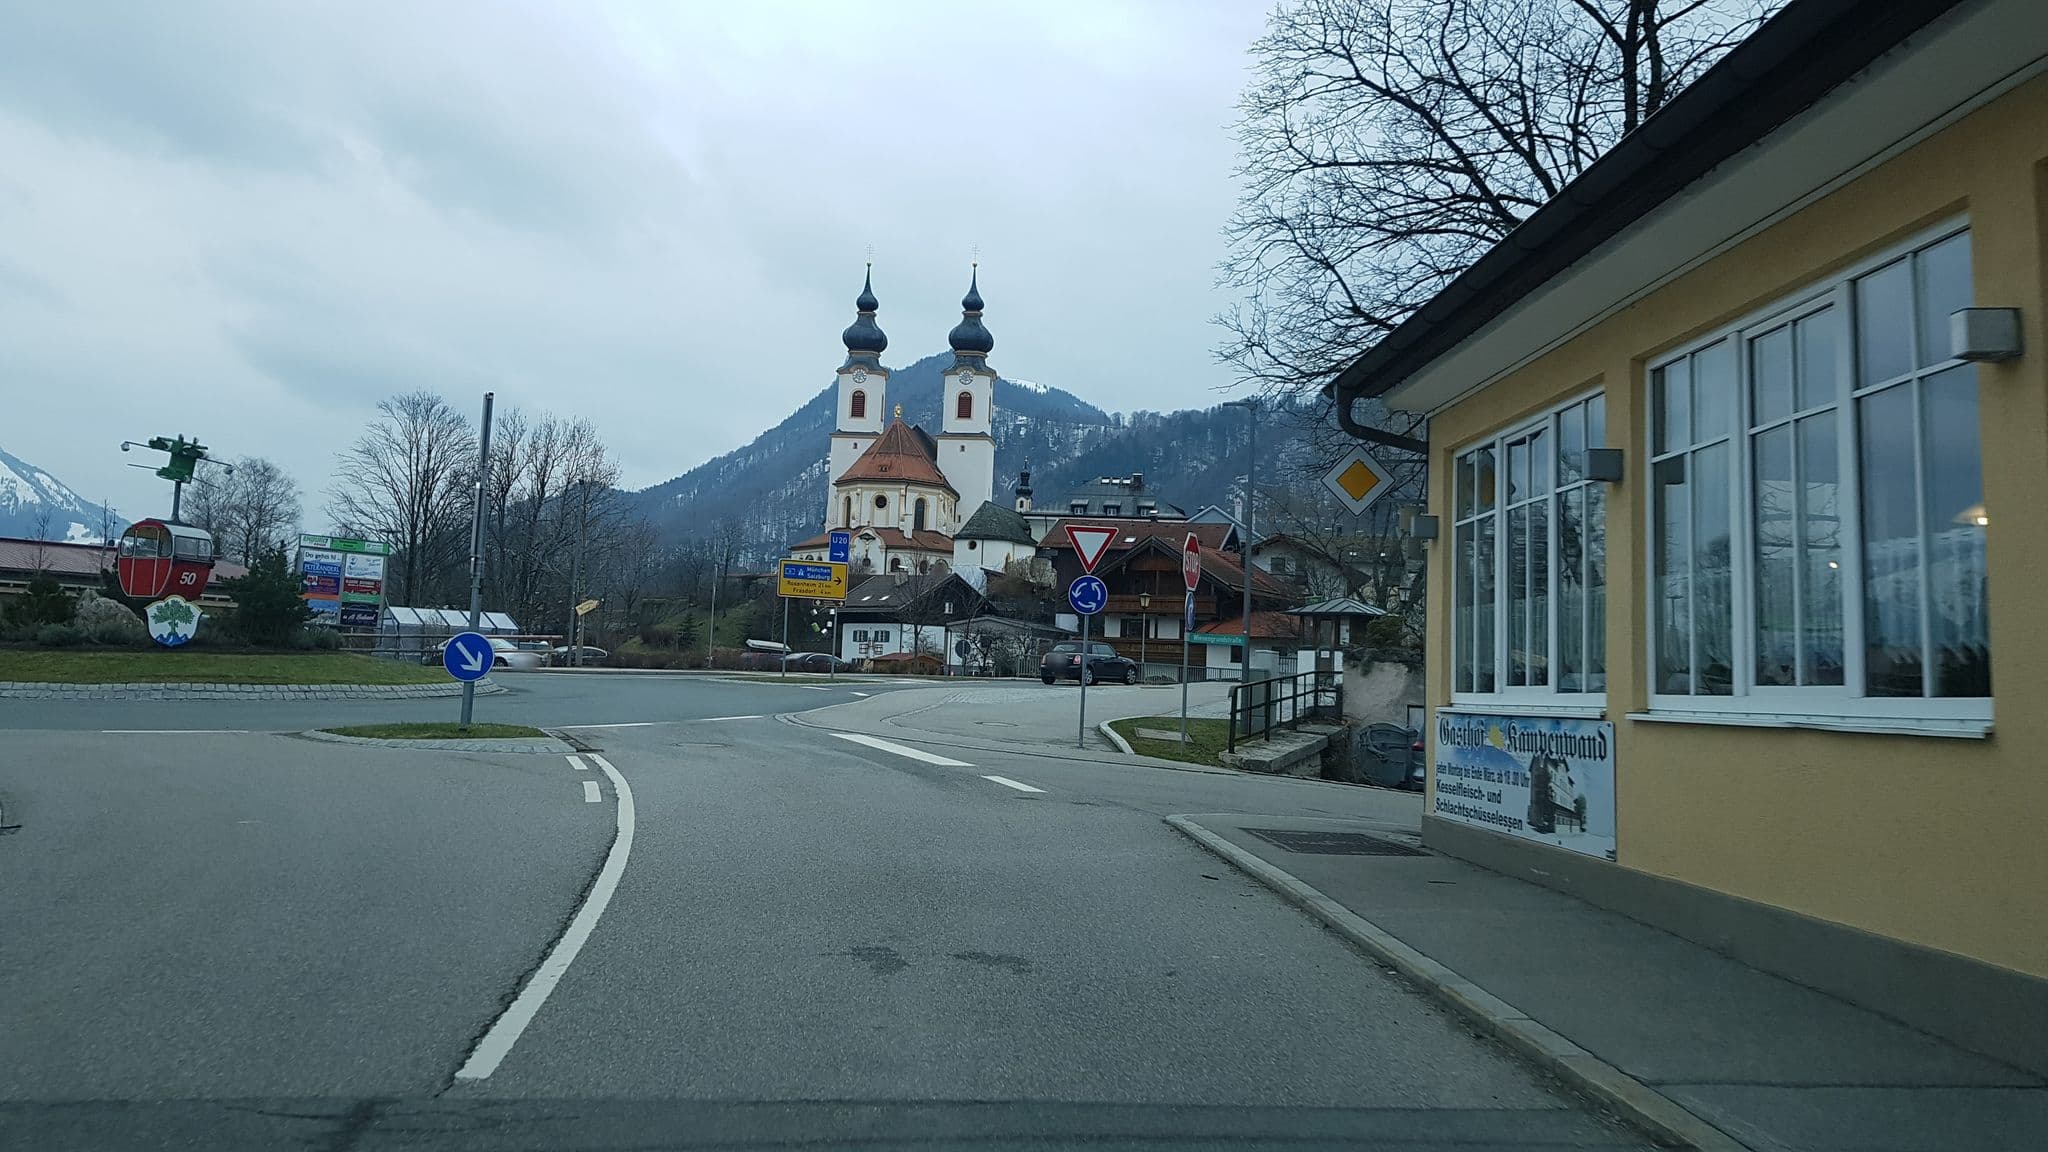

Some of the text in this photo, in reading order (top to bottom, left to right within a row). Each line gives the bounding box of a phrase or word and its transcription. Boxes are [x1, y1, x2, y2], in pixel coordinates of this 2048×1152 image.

[1186, 551, 1199, 574] STOP
[180, 572, 196, 585] 50
[806, 573, 830, 581] Salzburg
[1440, 717, 1608, 761] Gasthof Kampenwand
[1448, 763, 1463, 781] Montag
[1472, 766, 1482, 780] Ende
[1497, 770, 1503, 784] ab
[1520, 772, 1530, 788] Uhr
[1436, 779, 1502, 804] Kesselfleisch- und
[1436, 798, 1523, 831] Schlachtschüsselessen
